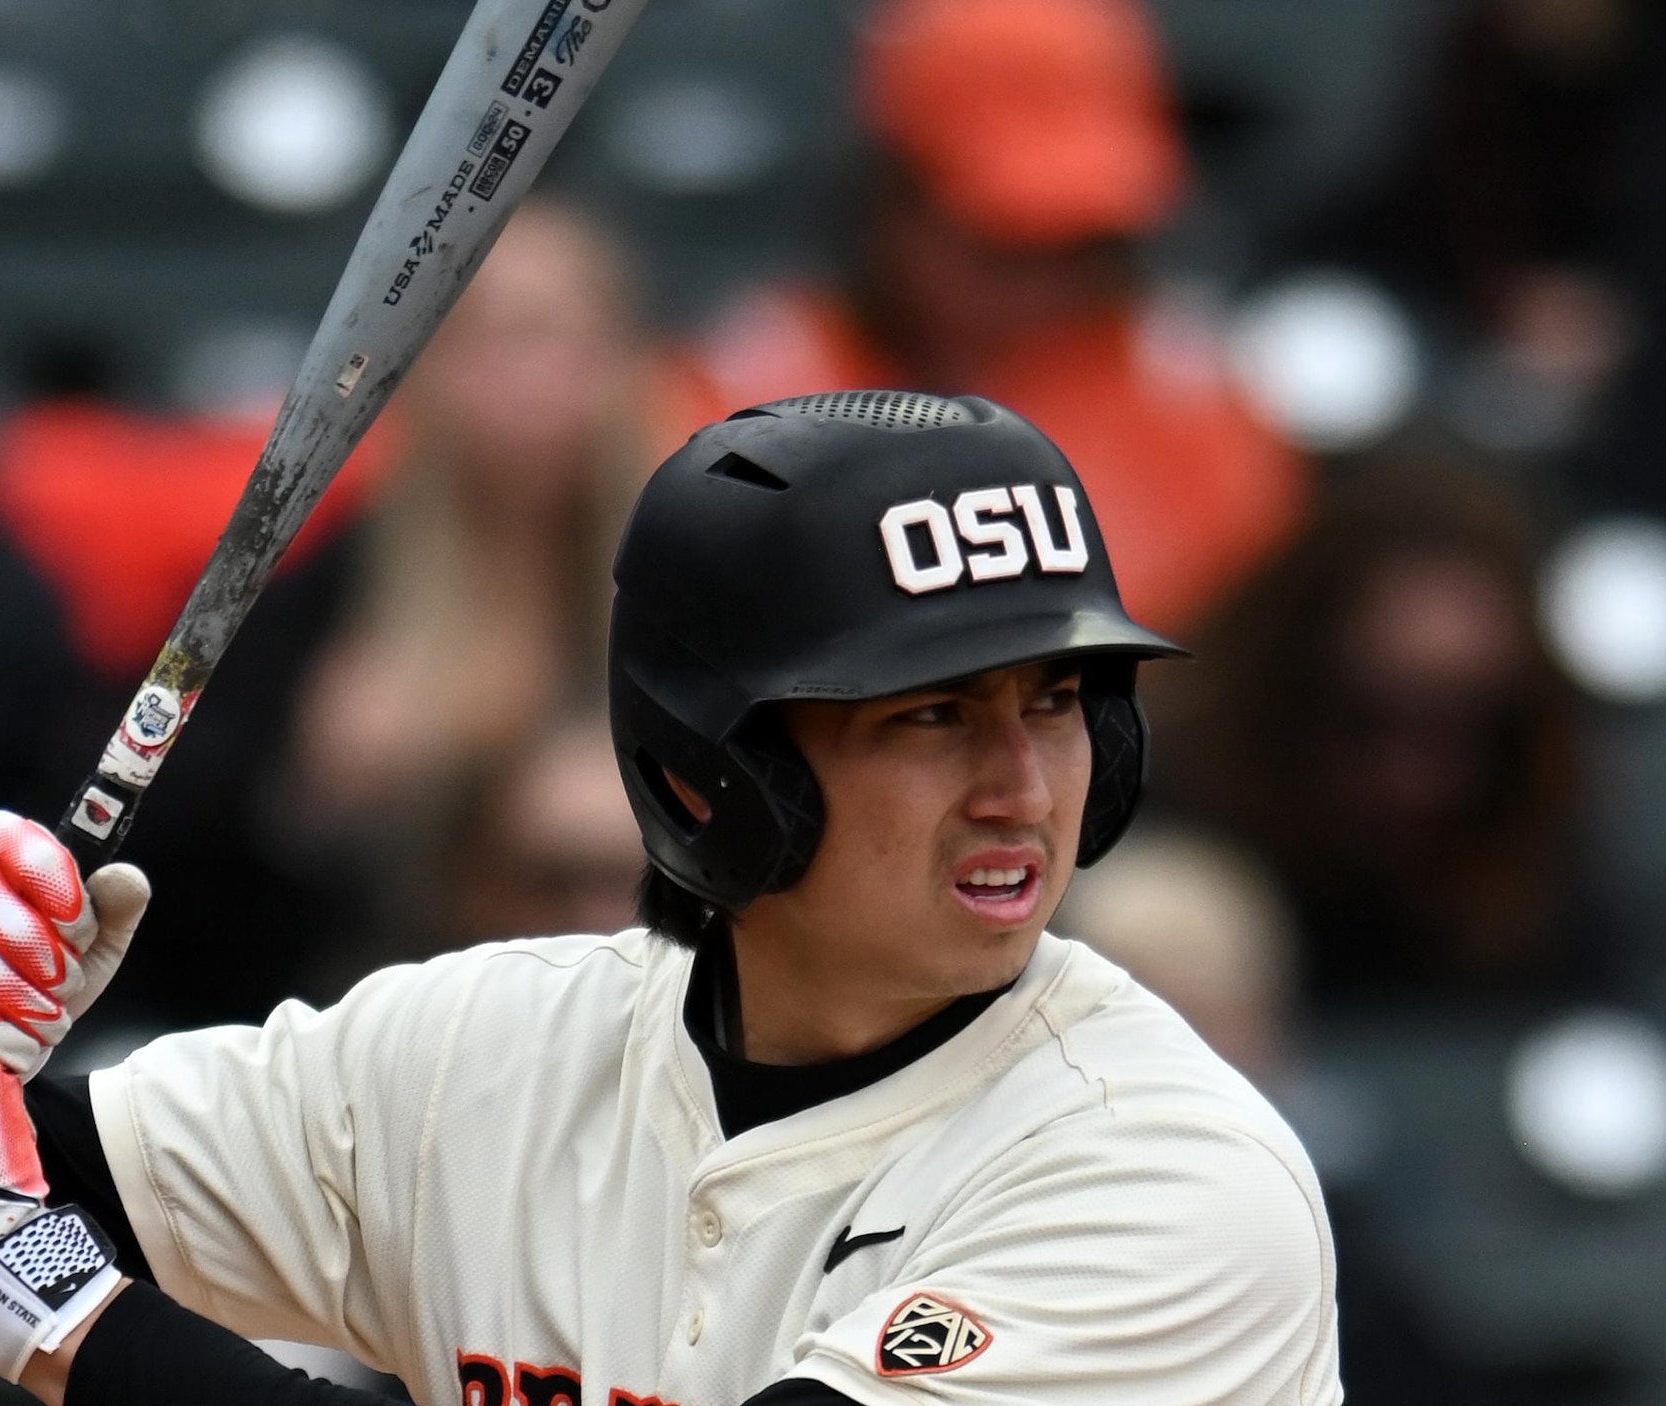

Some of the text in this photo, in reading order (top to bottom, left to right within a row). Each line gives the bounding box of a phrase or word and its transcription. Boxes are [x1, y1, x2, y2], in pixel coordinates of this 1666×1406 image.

[555, 15, 592, 66] The
[383, 160, 474, 306] USA MADE
[879, 484, 1089, 596] OSU
[7, 1300, 41, 1328] STATE
[886, 1296, 986, 1366] PAC
[883, 1328, 942, 1367] 12
